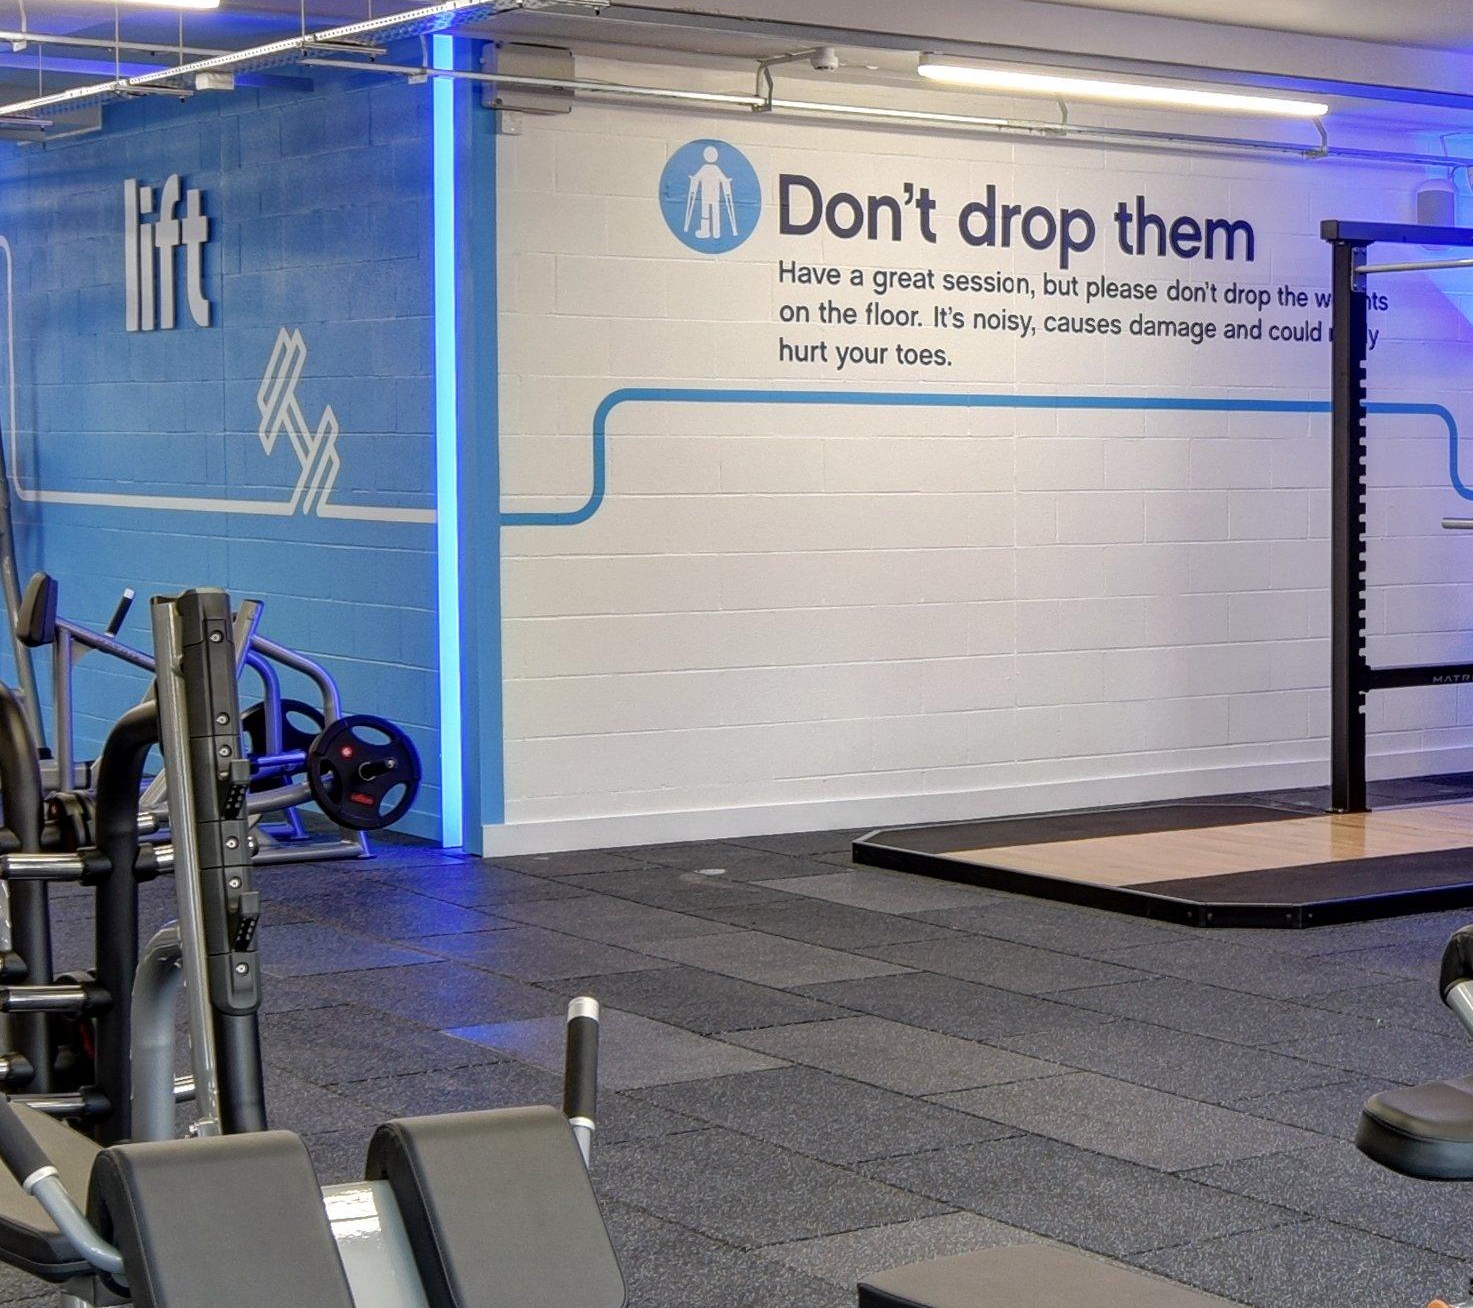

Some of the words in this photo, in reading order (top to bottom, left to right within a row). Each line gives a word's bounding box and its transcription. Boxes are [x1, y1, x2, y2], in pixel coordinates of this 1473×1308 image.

[779, 174, 937, 244] Don't
[958, 184, 1096, 270] drop
[1113, 195, 1255, 262] them
[123, 173, 211, 332] lift
[778, 260, 841, 285] Have
[850, 268, 864, 286] a
[873, 268, 935, 295] great
[942, 271, 1035, 299] session,
[1043, 272, 1079, 298] but
[1086, 275, 1158, 303] please
[1166, 279, 1217, 304] don't
[1223, 281, 1271, 310] drop
[1277, 285, 1308, 308] the
[779, 303, 809, 322] on
[818, 300, 857, 324] the
[865, 301, 923, 327] floor.
[933, 306, 965, 329] It's
[973, 309, 1036, 338] noisy,
[1043, 315, 1122, 335] causes
[1129, 314, 1217, 344] damage
[1223, 319, 1262, 341] and
[1268, 320, 1322, 342] could
[779, 337, 828, 363] hurt
[836, 344, 888, 370] your
[896, 343, 952, 366] toes.
